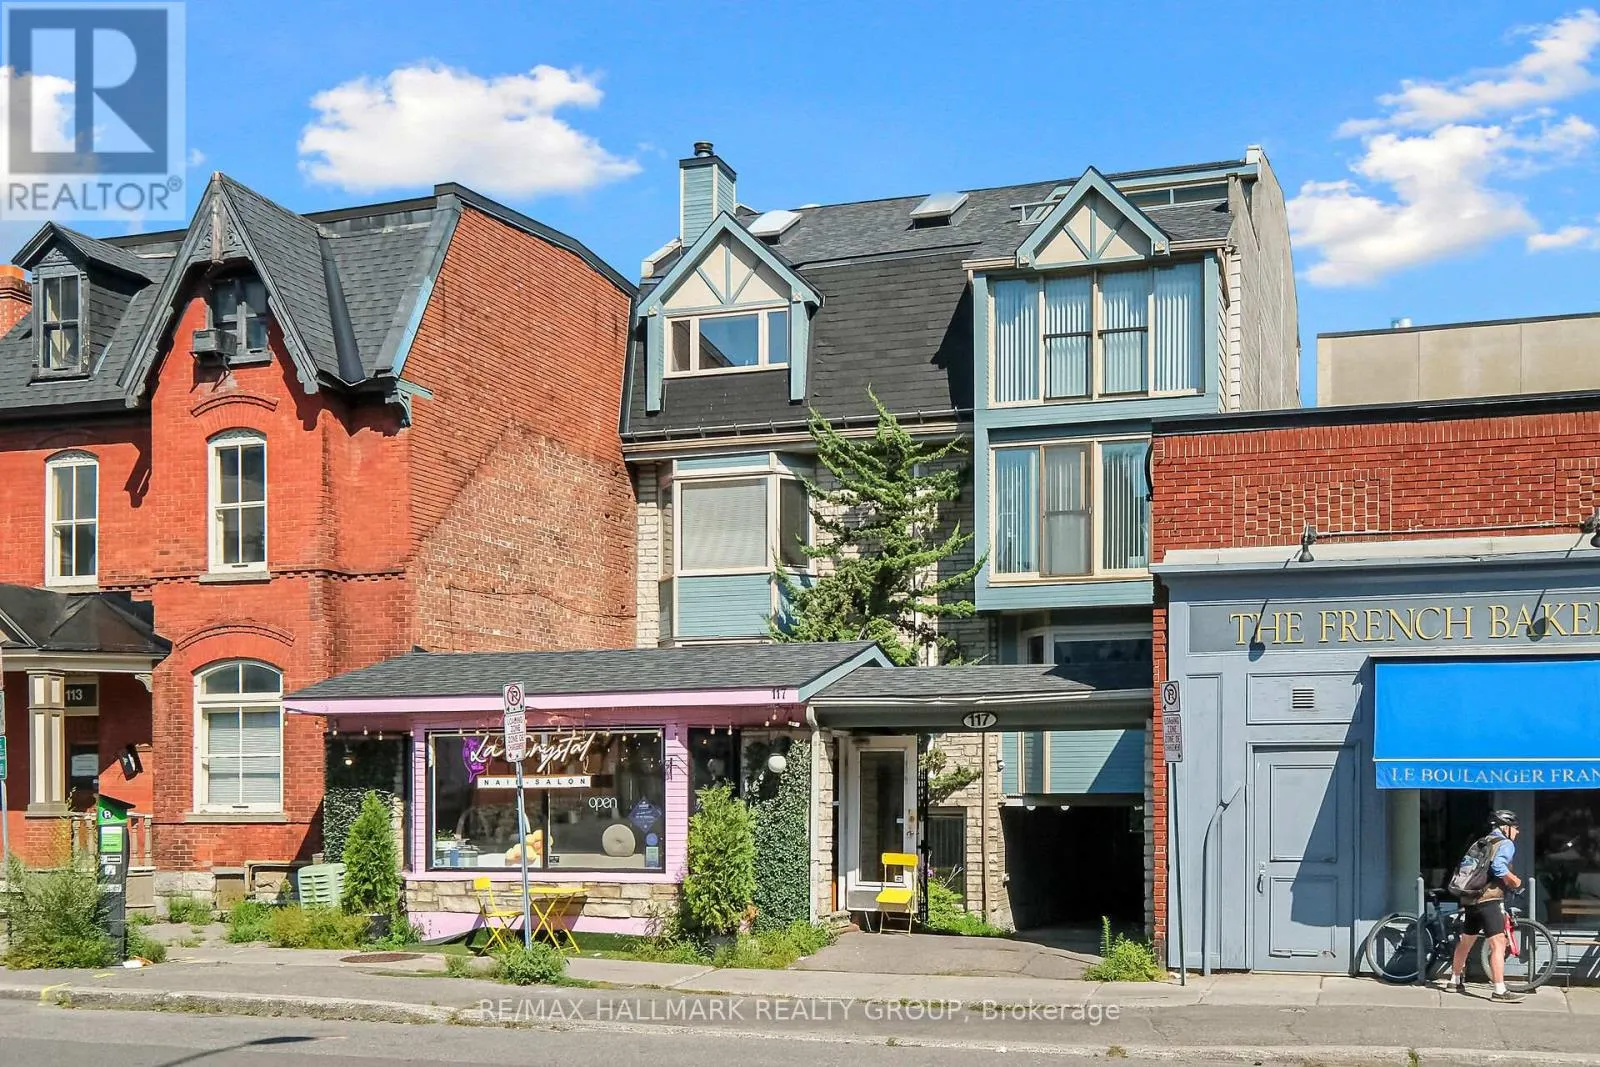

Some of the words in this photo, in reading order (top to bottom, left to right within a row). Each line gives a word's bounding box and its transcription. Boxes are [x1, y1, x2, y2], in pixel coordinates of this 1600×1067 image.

[1228, 611, 1305, 645] THE
[1318, 606, 1475, 643] FRENCH
[1488, 601, 1600, 639] BAKE
[65, 689, 83, 701] 113
[772, 688, 787, 700] 117
[968, 714, 990, 727] 117
[470, 735, 505, 763] La
[1391, 767, 1415, 782] LE
[1421, 768, 1545, 784] BOULANGER
[588, 797, 618, 812] open
